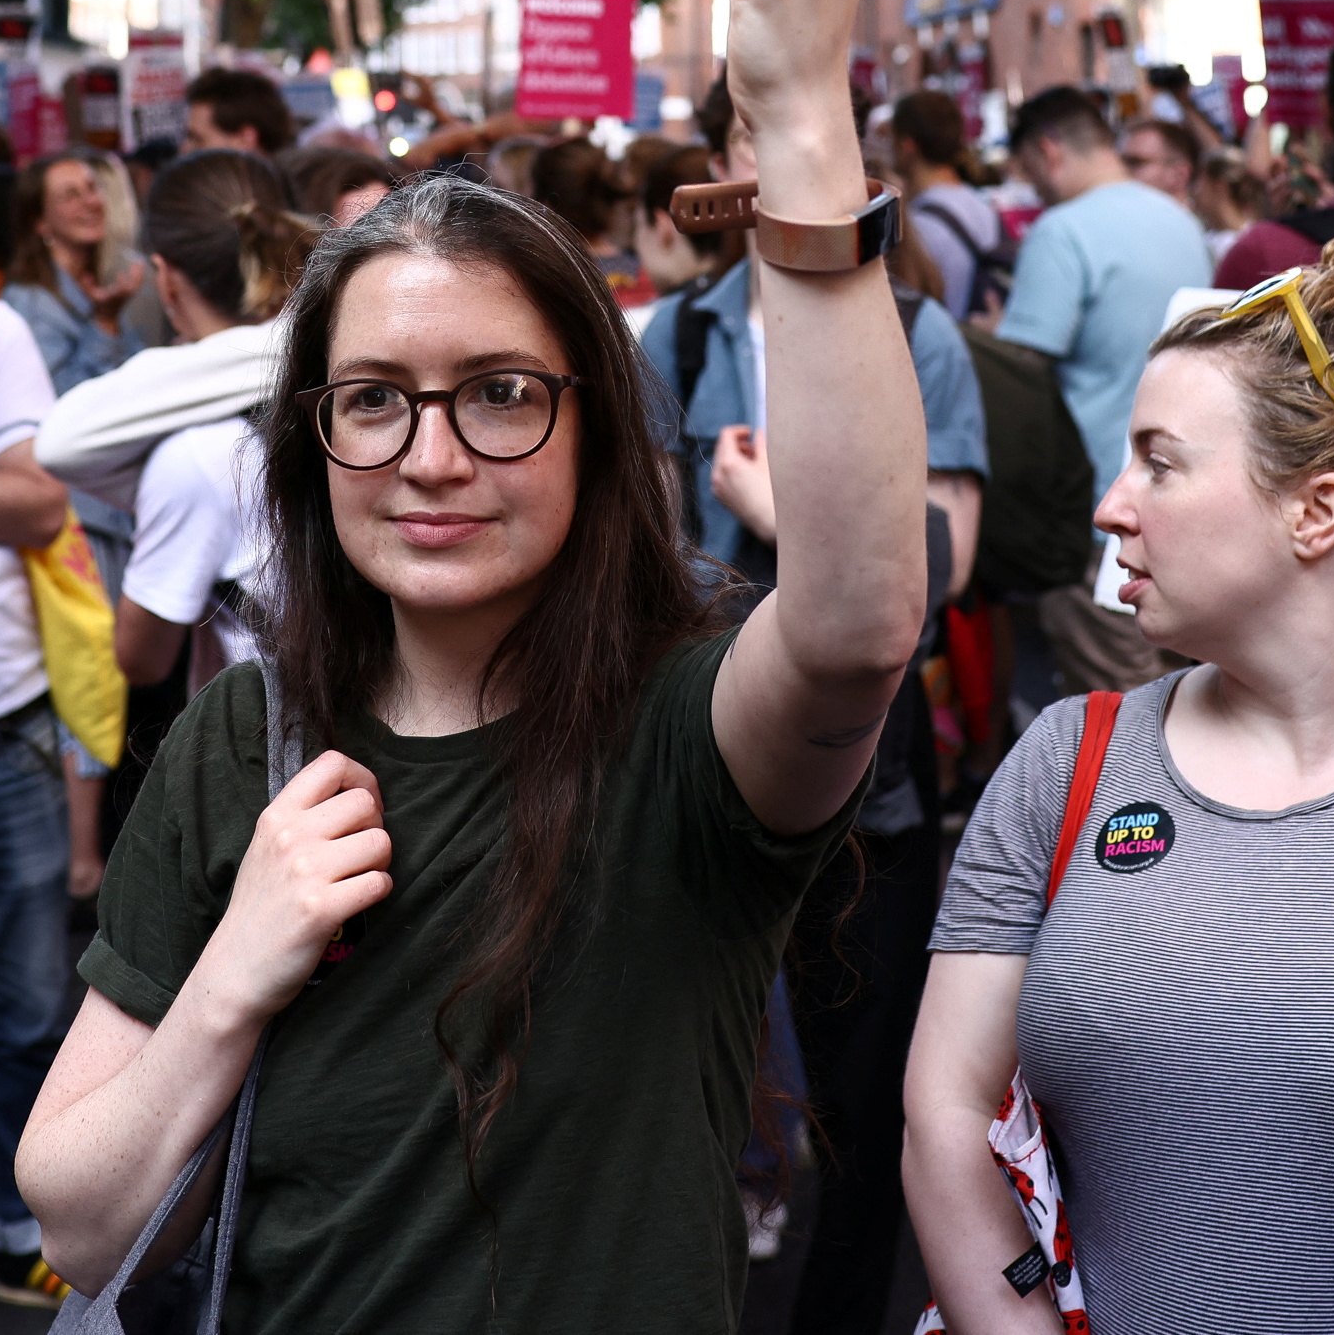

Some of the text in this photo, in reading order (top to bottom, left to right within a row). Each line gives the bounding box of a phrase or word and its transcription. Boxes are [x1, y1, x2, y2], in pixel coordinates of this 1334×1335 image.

[1108, 812, 1159, 831] STAND
[1106, 826, 1154, 844] UP TO
[1105, 839, 1165, 857] RACISM
